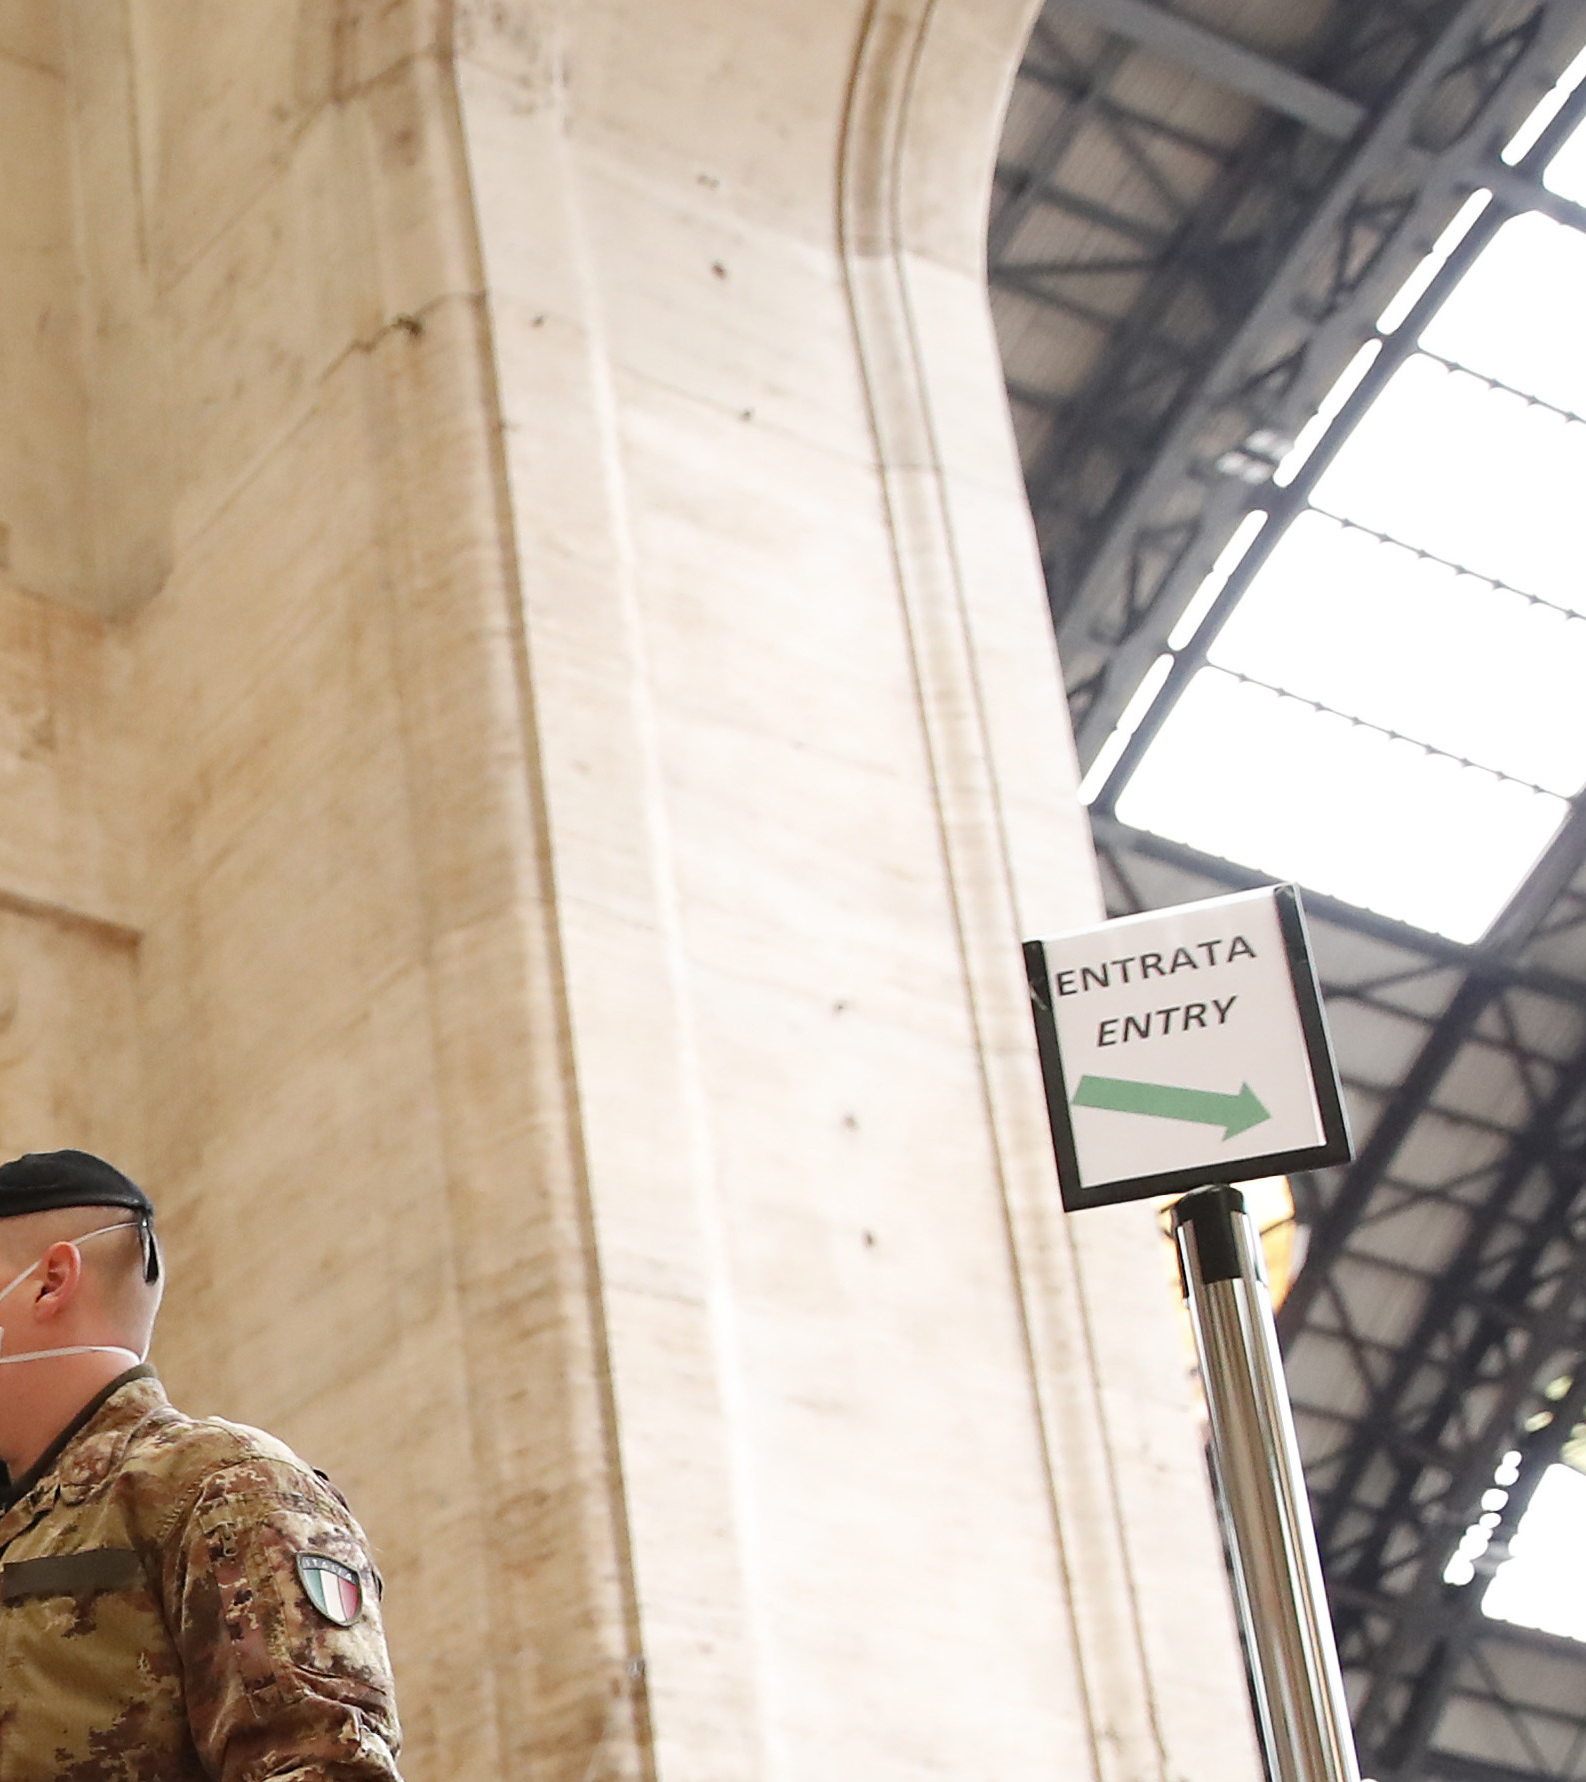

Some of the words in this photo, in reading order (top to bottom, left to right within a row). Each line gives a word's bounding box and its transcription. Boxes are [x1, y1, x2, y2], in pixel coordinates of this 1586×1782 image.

[1056, 935, 1257, 996] ENTRATA
[1097, 995, 1238, 1047] ENTRY
[305, 1557, 353, 1581] ITALIA
